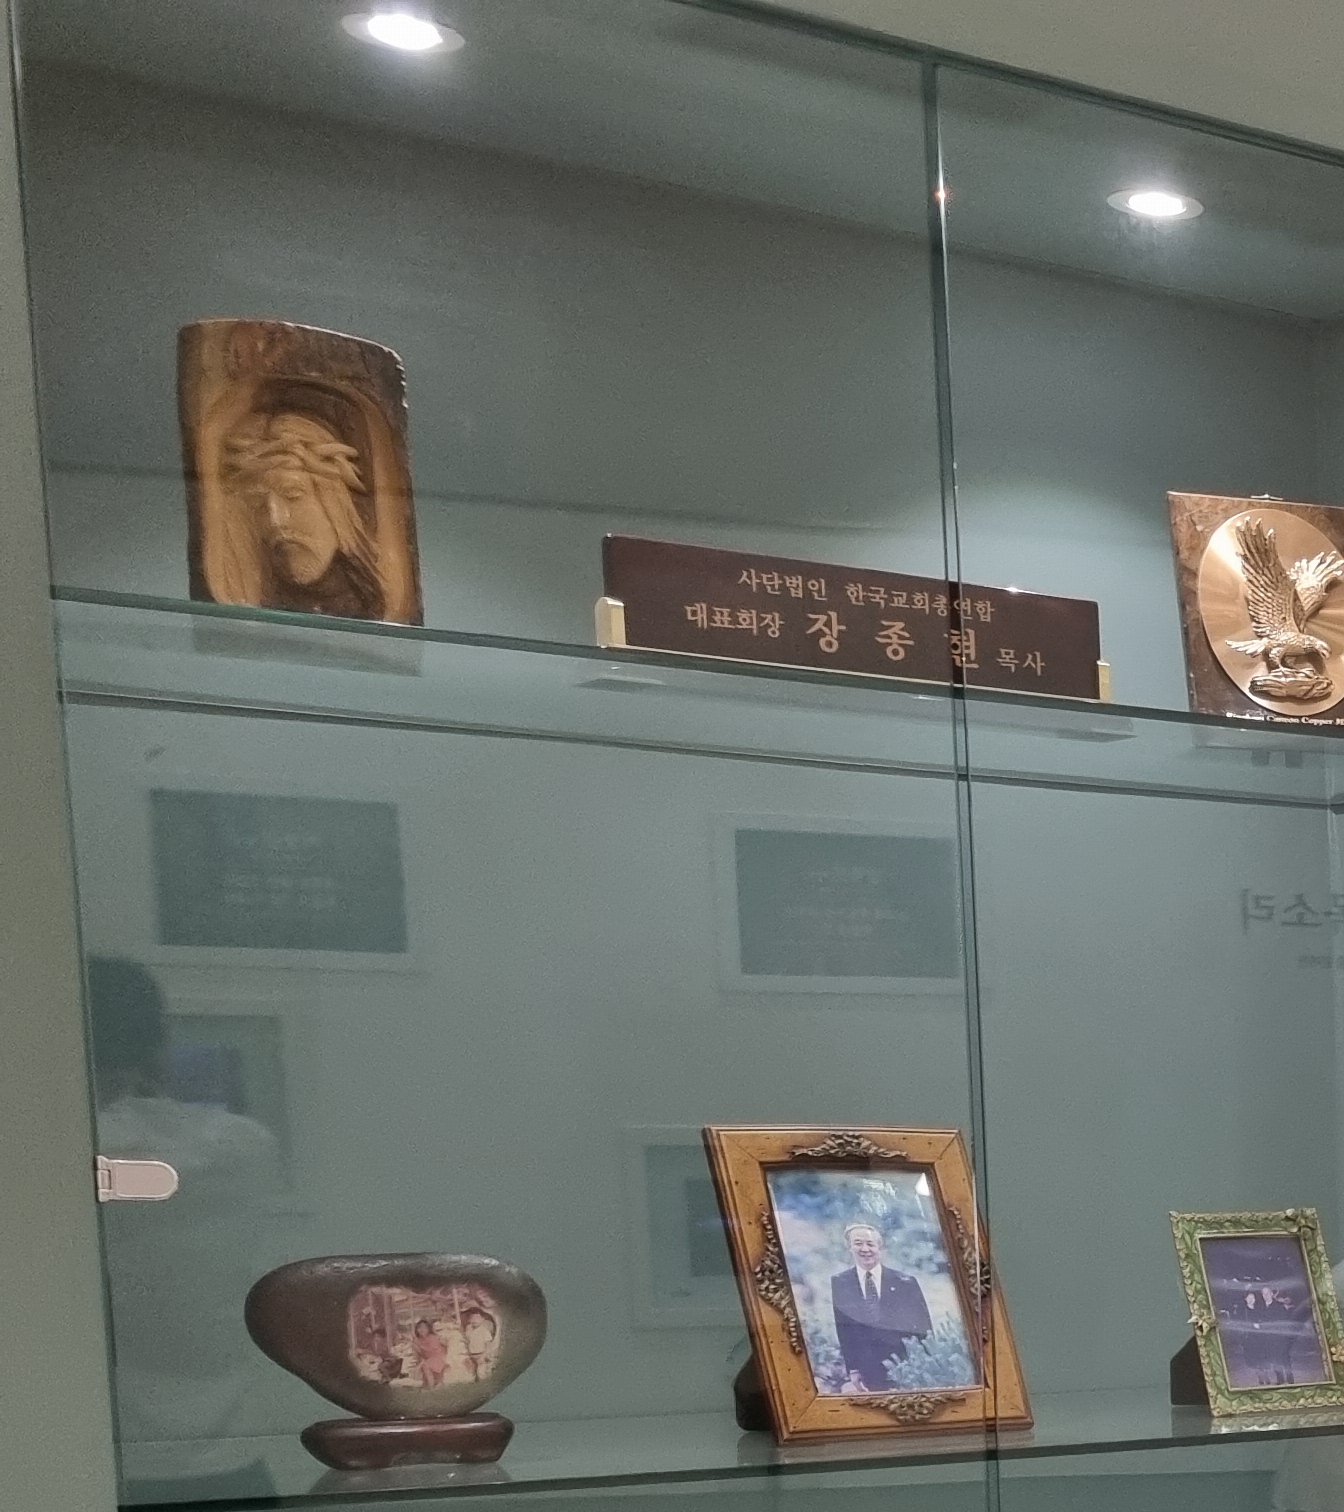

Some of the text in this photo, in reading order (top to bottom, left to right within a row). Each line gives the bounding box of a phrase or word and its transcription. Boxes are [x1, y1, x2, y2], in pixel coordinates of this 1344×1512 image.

[738, 568, 995, 623] 사단법인 한국교회총연합
[684, 602, 784, 638] 대표회장
[805, 610, 846, 655] 장
[875, 619, 914, 662] 종
[996, 648, 1046, 677] 목사
